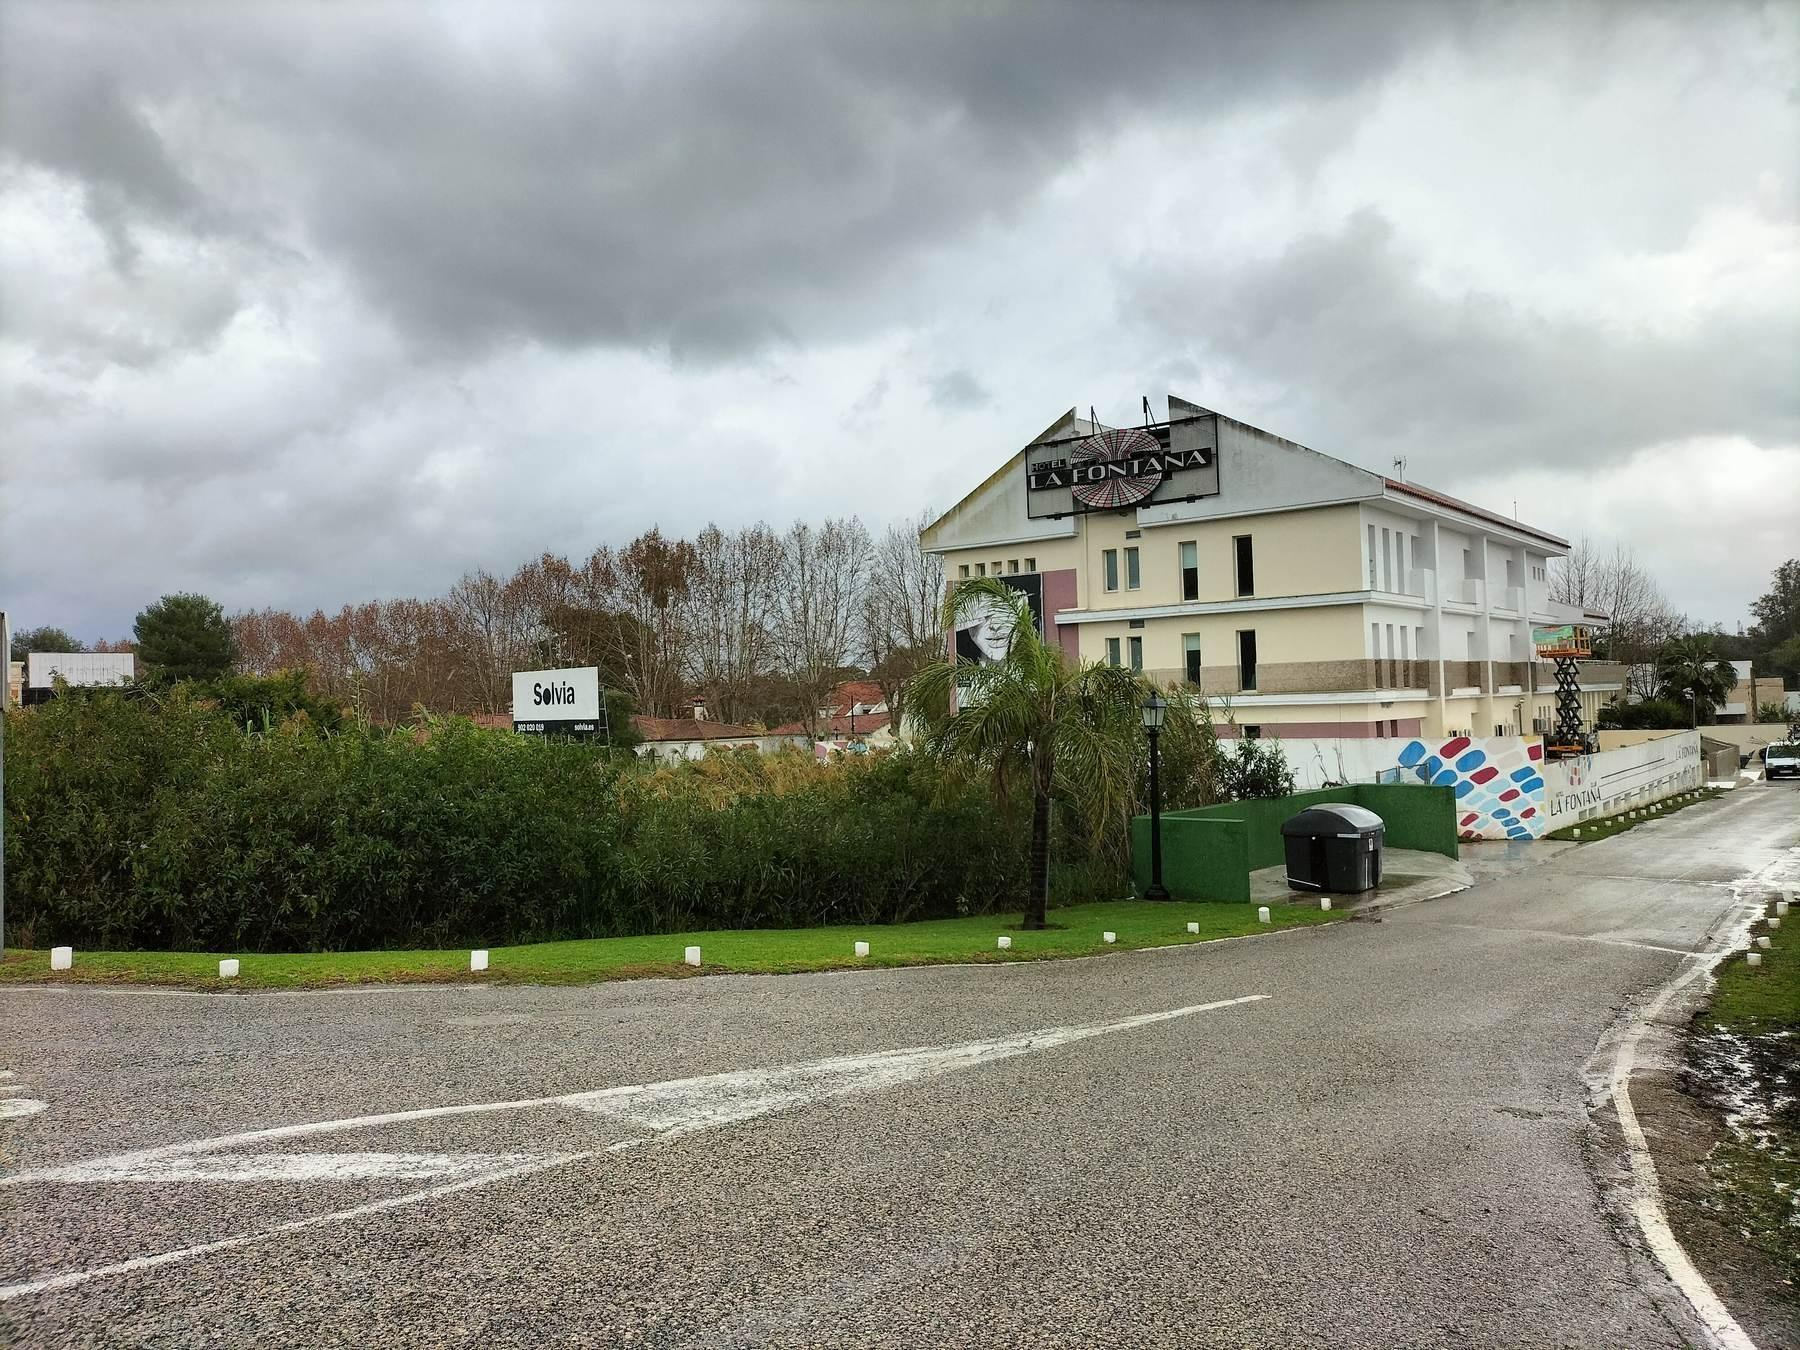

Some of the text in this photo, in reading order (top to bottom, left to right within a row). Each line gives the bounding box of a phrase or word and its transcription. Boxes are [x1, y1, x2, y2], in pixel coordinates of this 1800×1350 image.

[1030, 450, 1207, 489] LA FONTANA
[1032, 459, 1065, 472] HOTEL
[533, 681, 576, 705] Solvia
[574, 722, 595, 731] solvia.es
[1550, 787, 1602, 817] LA FONTANA
